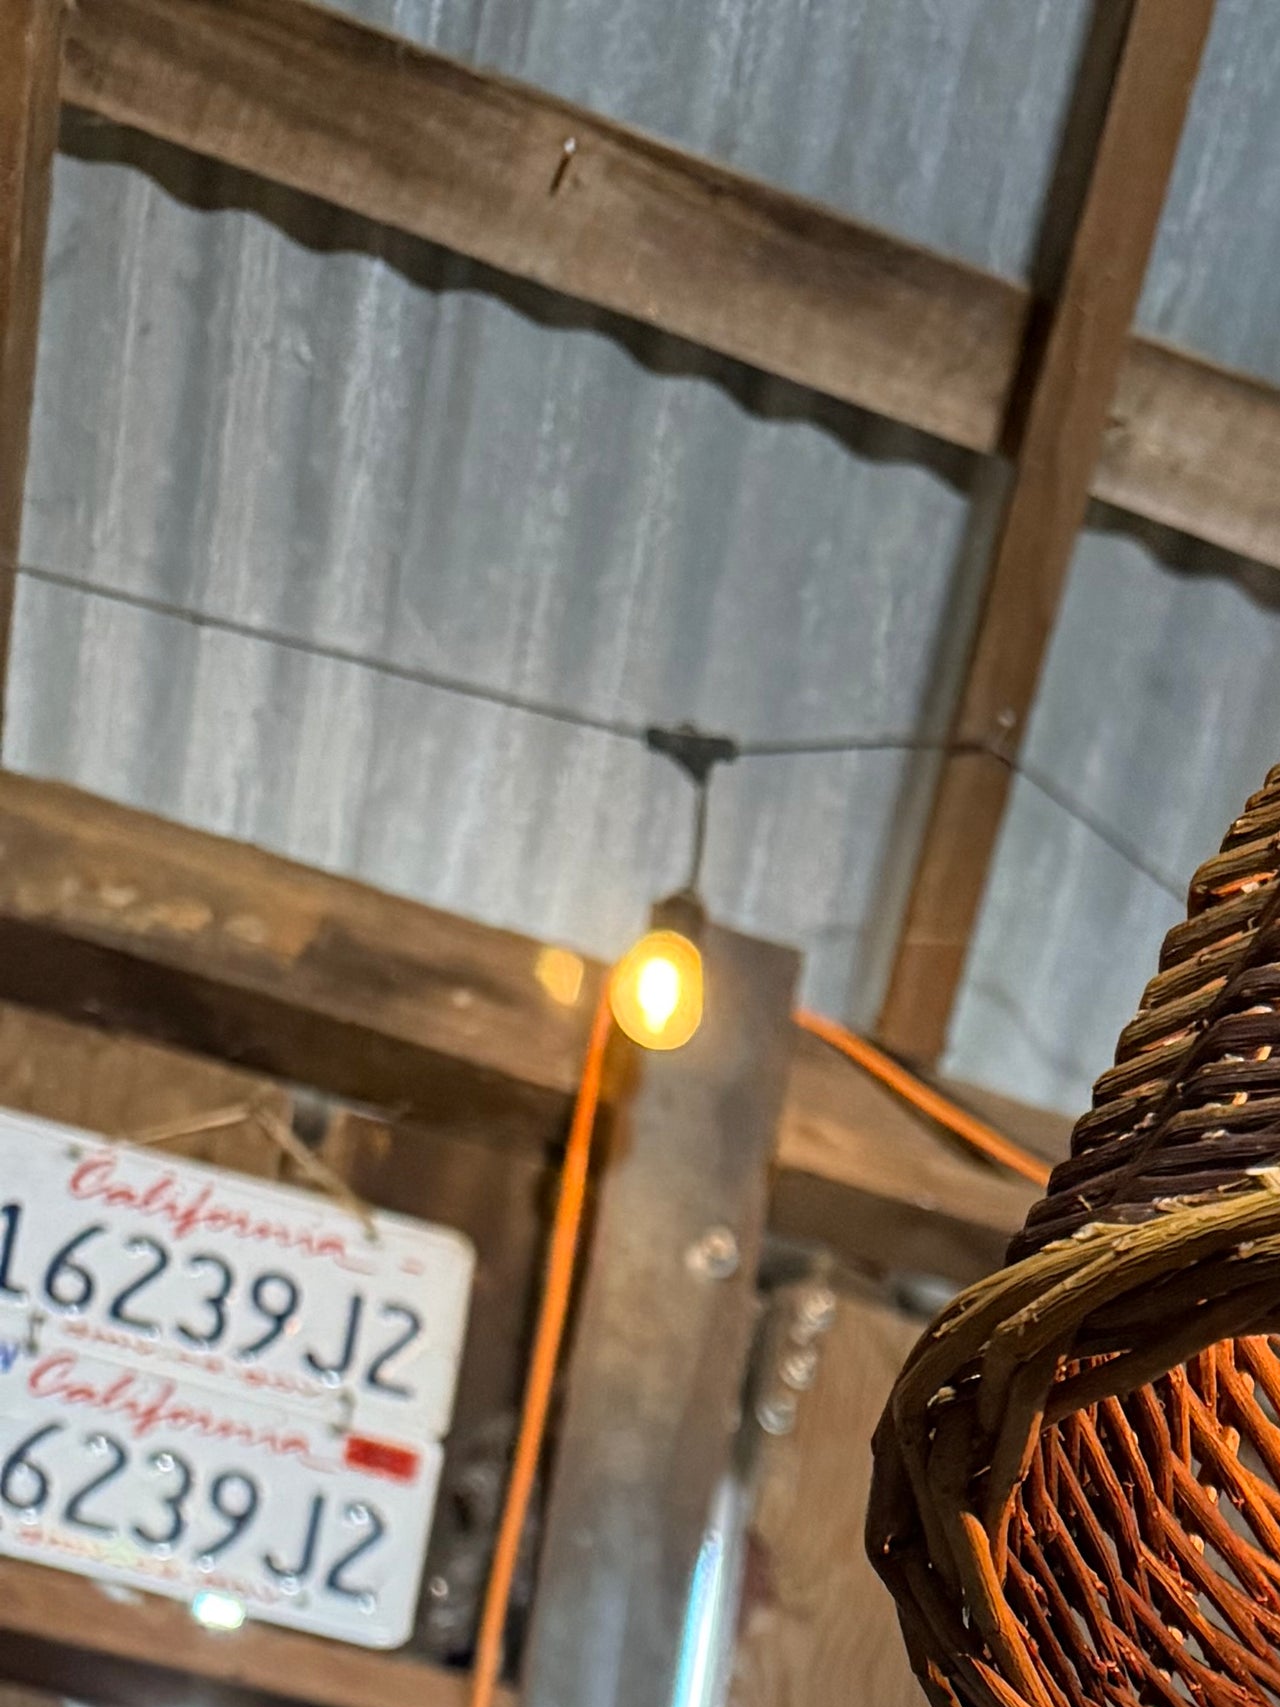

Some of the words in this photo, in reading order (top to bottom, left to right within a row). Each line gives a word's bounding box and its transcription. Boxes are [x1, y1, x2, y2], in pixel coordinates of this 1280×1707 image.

[70, 1152, 376, 1275] California
[0, 1203, 424, 1398] 16239J2
[29, 1354, 337, 1474] California
[0, 1421, 386, 1600] 6239J2
